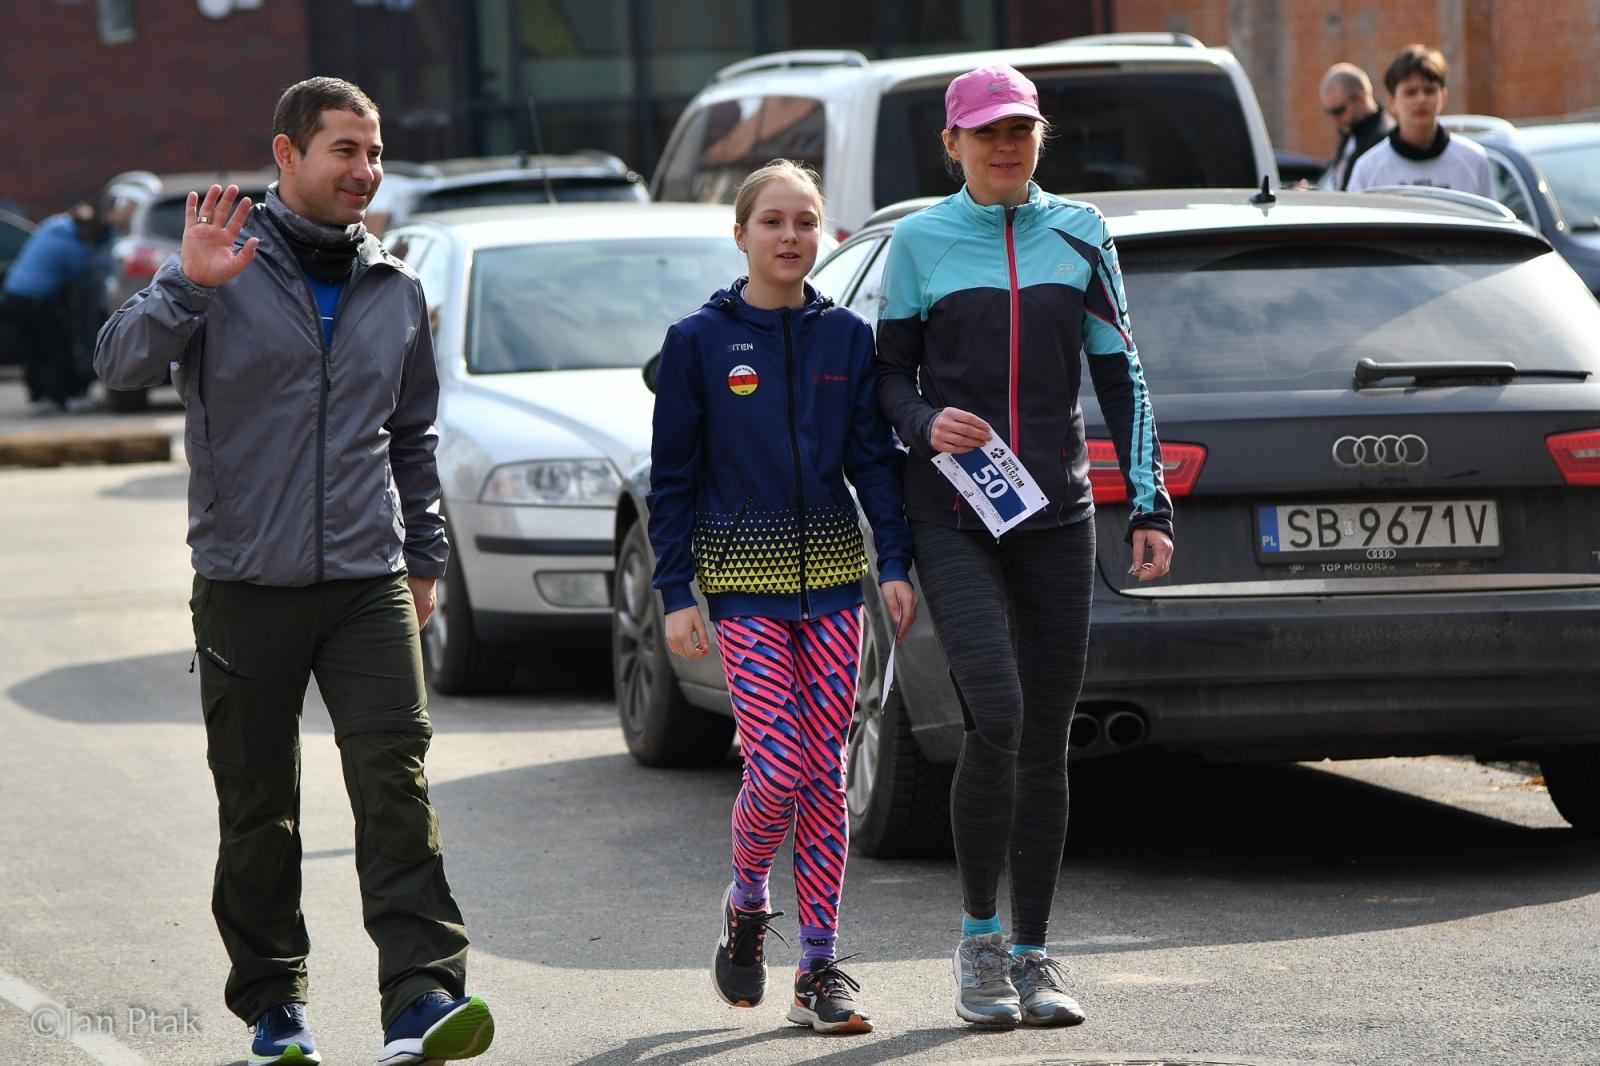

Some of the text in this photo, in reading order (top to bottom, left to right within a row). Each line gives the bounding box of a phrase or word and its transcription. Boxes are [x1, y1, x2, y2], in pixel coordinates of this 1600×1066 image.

[1000, 459, 1025, 488] WILCZYM
[1006, 456, 1020, 471] TROPEM
[972, 463, 1009, 499] 50
[1287, 504, 1488, 549] SB 9671V
[1262, 535, 1277, 546] PL
[1320, 563, 1341, 573] TOP
[1344, 562, 1387, 572] MOTORS
